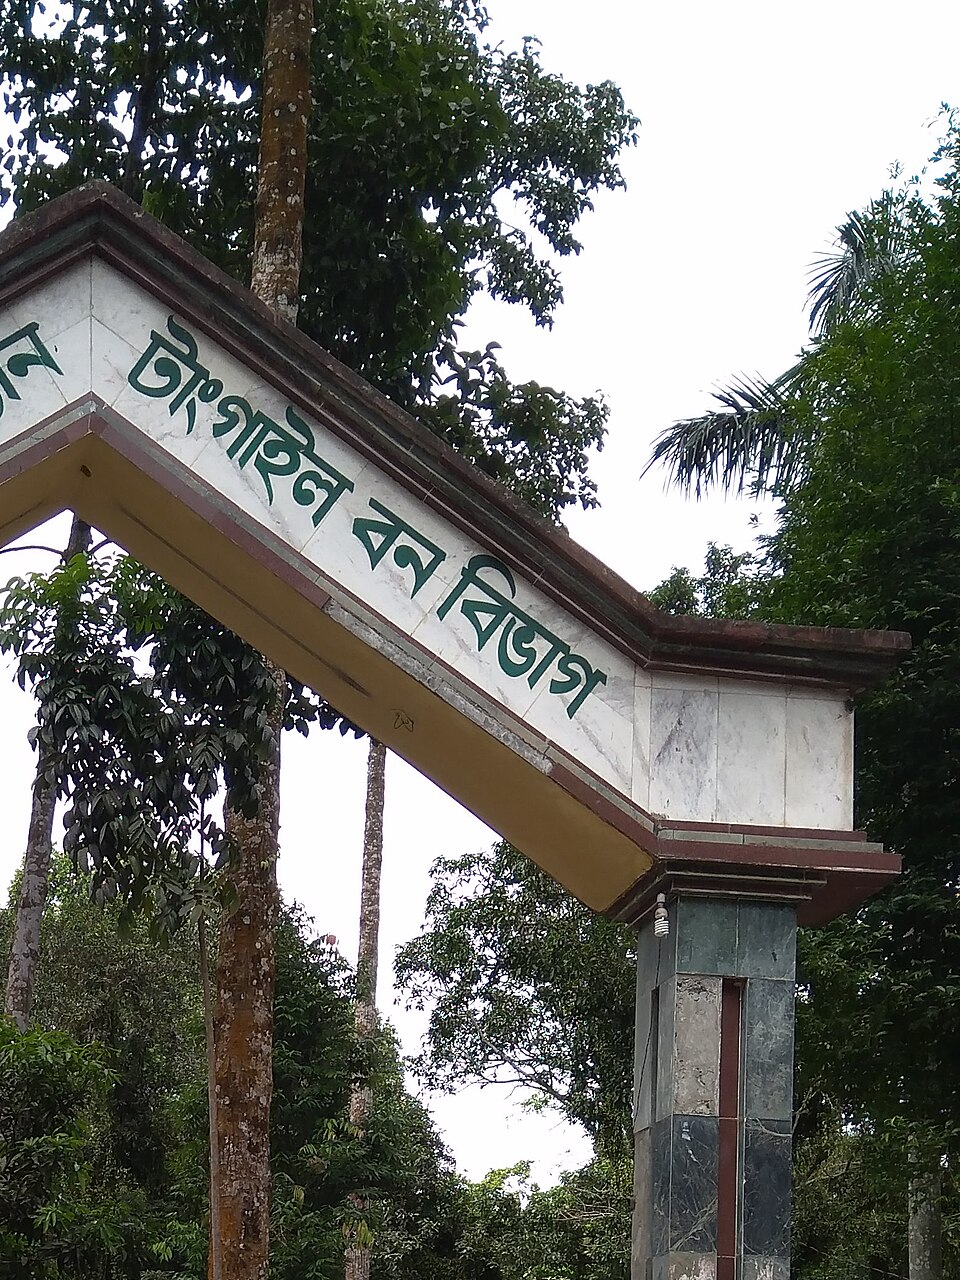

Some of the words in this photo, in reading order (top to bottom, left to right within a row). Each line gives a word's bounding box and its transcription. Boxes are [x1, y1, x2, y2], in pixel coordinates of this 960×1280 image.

[128, 315, 354, 528] টাংগাইল
[352, 496, 446, 599] বন
[437, 554, 607, 720] বিভাগ
